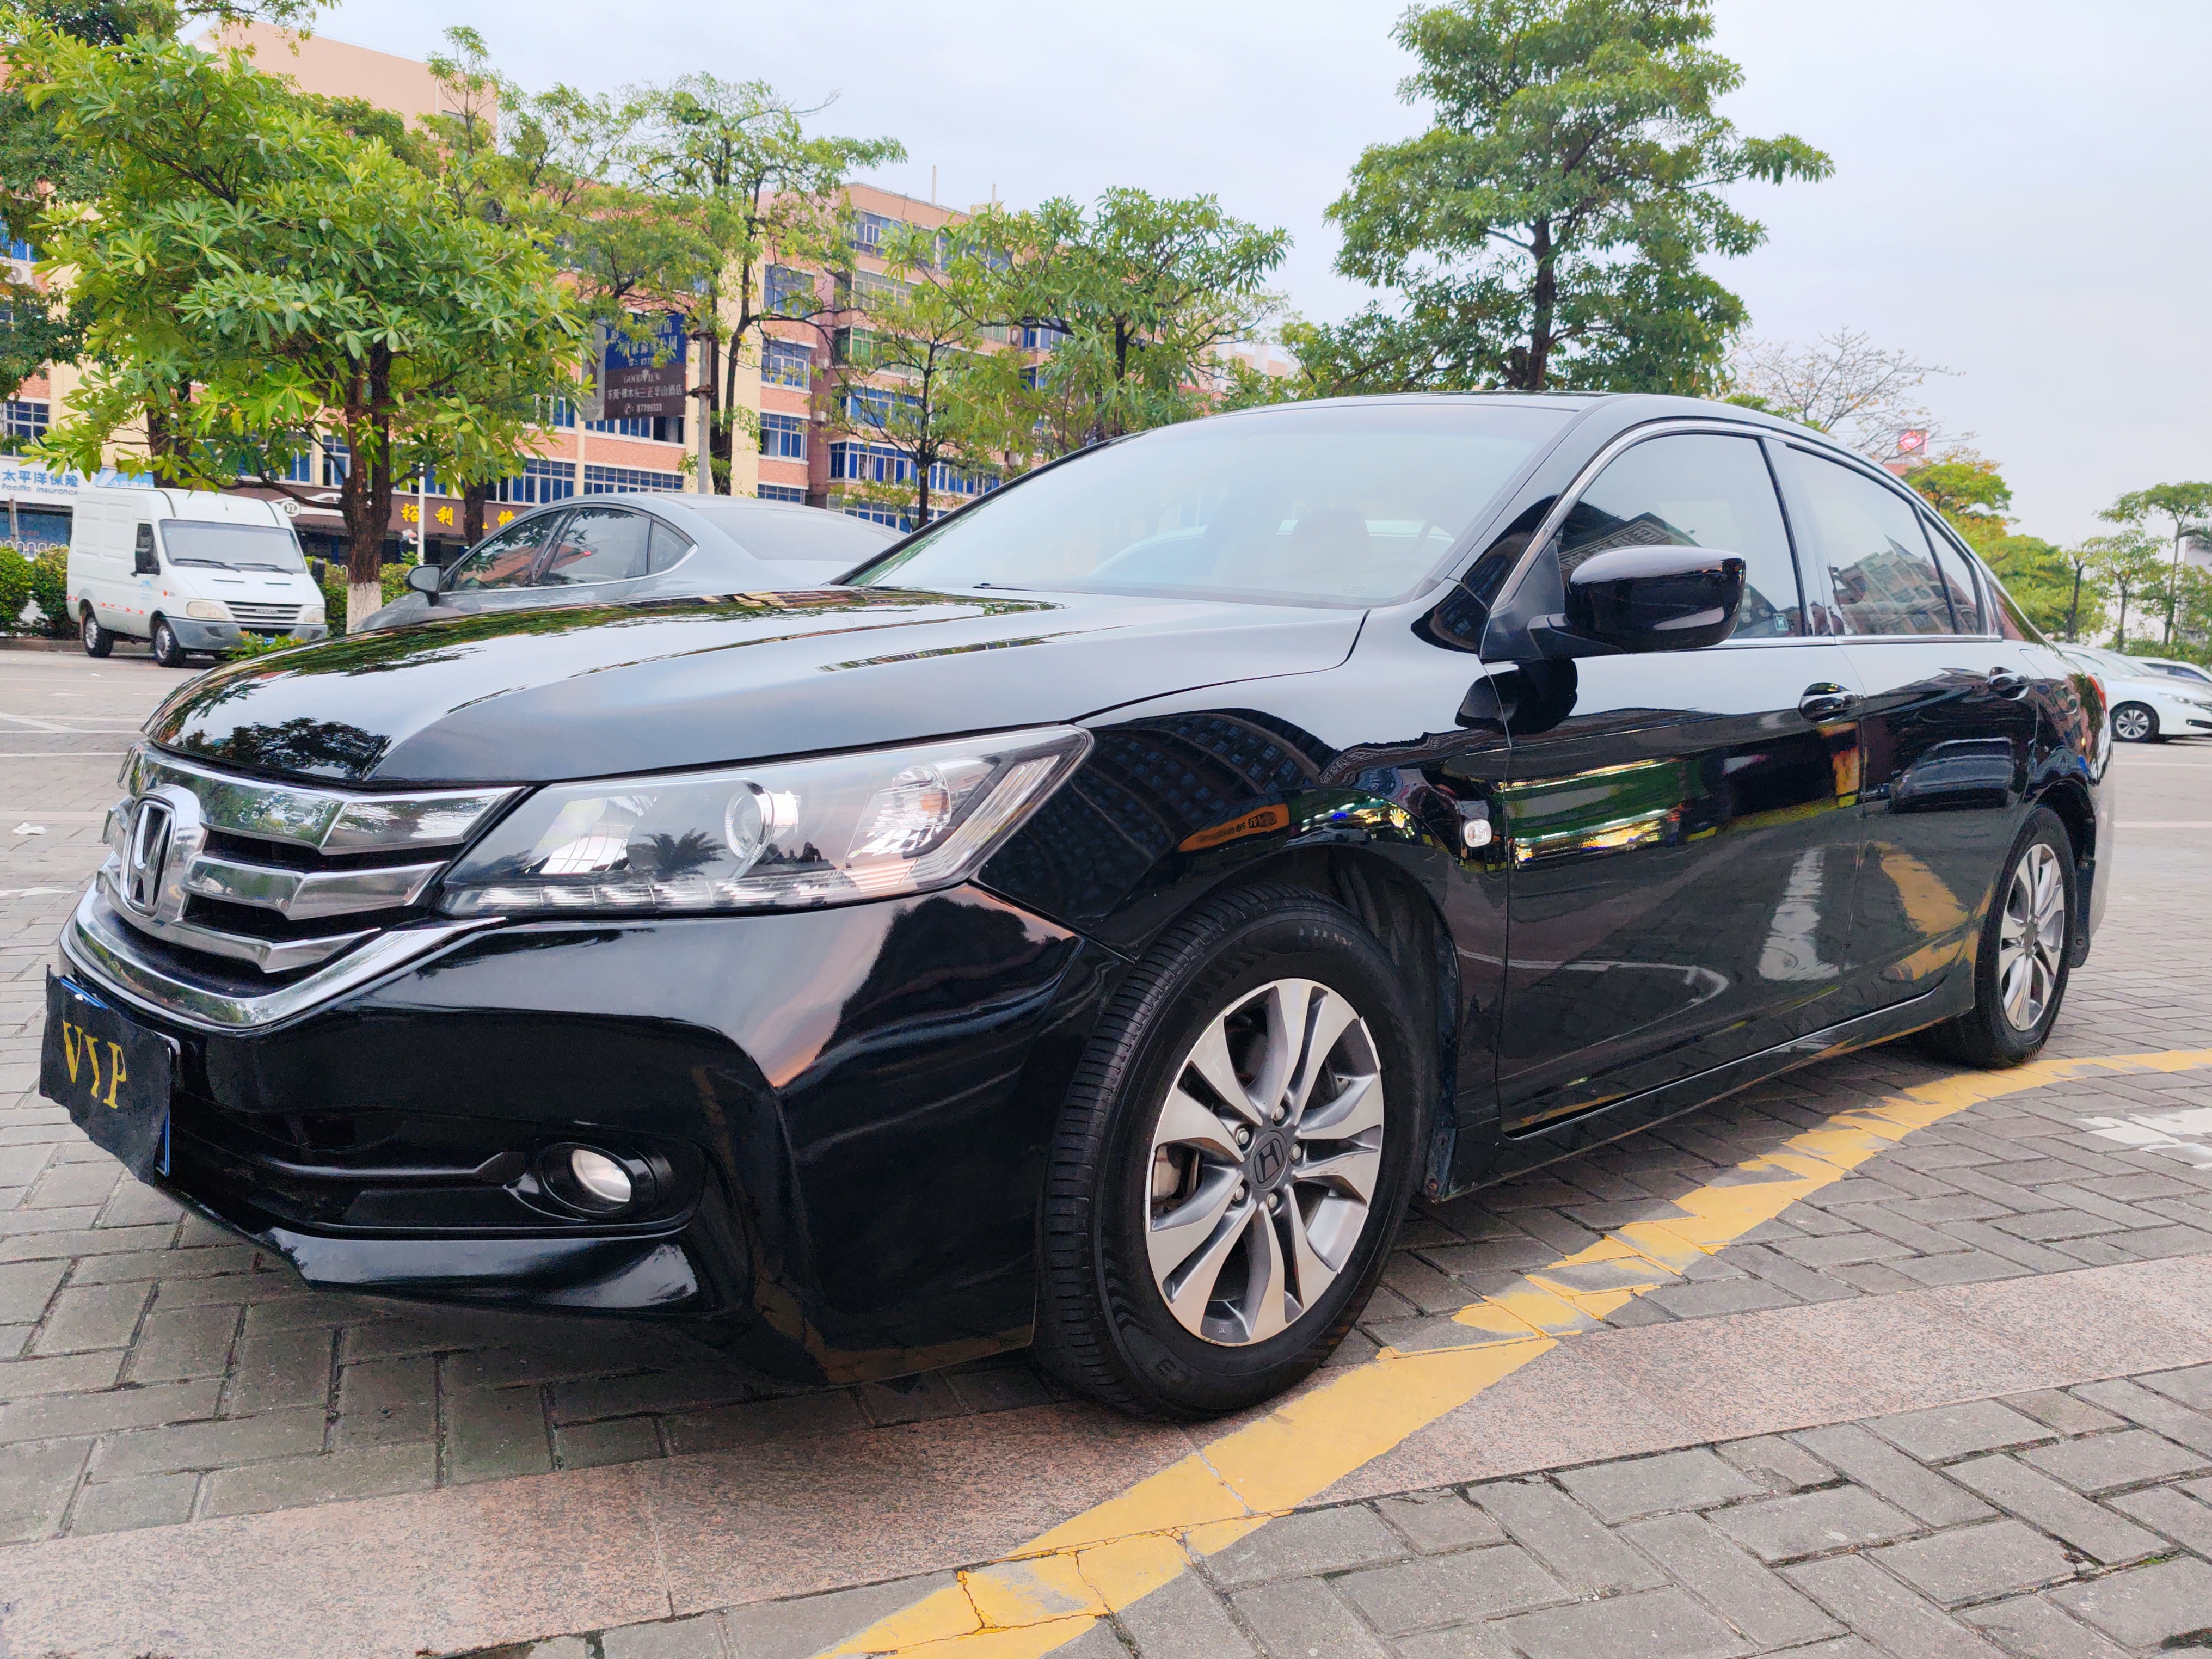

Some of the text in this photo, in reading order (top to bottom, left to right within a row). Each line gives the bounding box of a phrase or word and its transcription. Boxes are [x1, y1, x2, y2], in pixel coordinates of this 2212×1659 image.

[2, 469, 79, 487] 太平洋保险
[2, 483, 32, 492] Pacific
[401, 503, 515, 530] 裕利修
[63, 1019, 127, 1109] VIP
